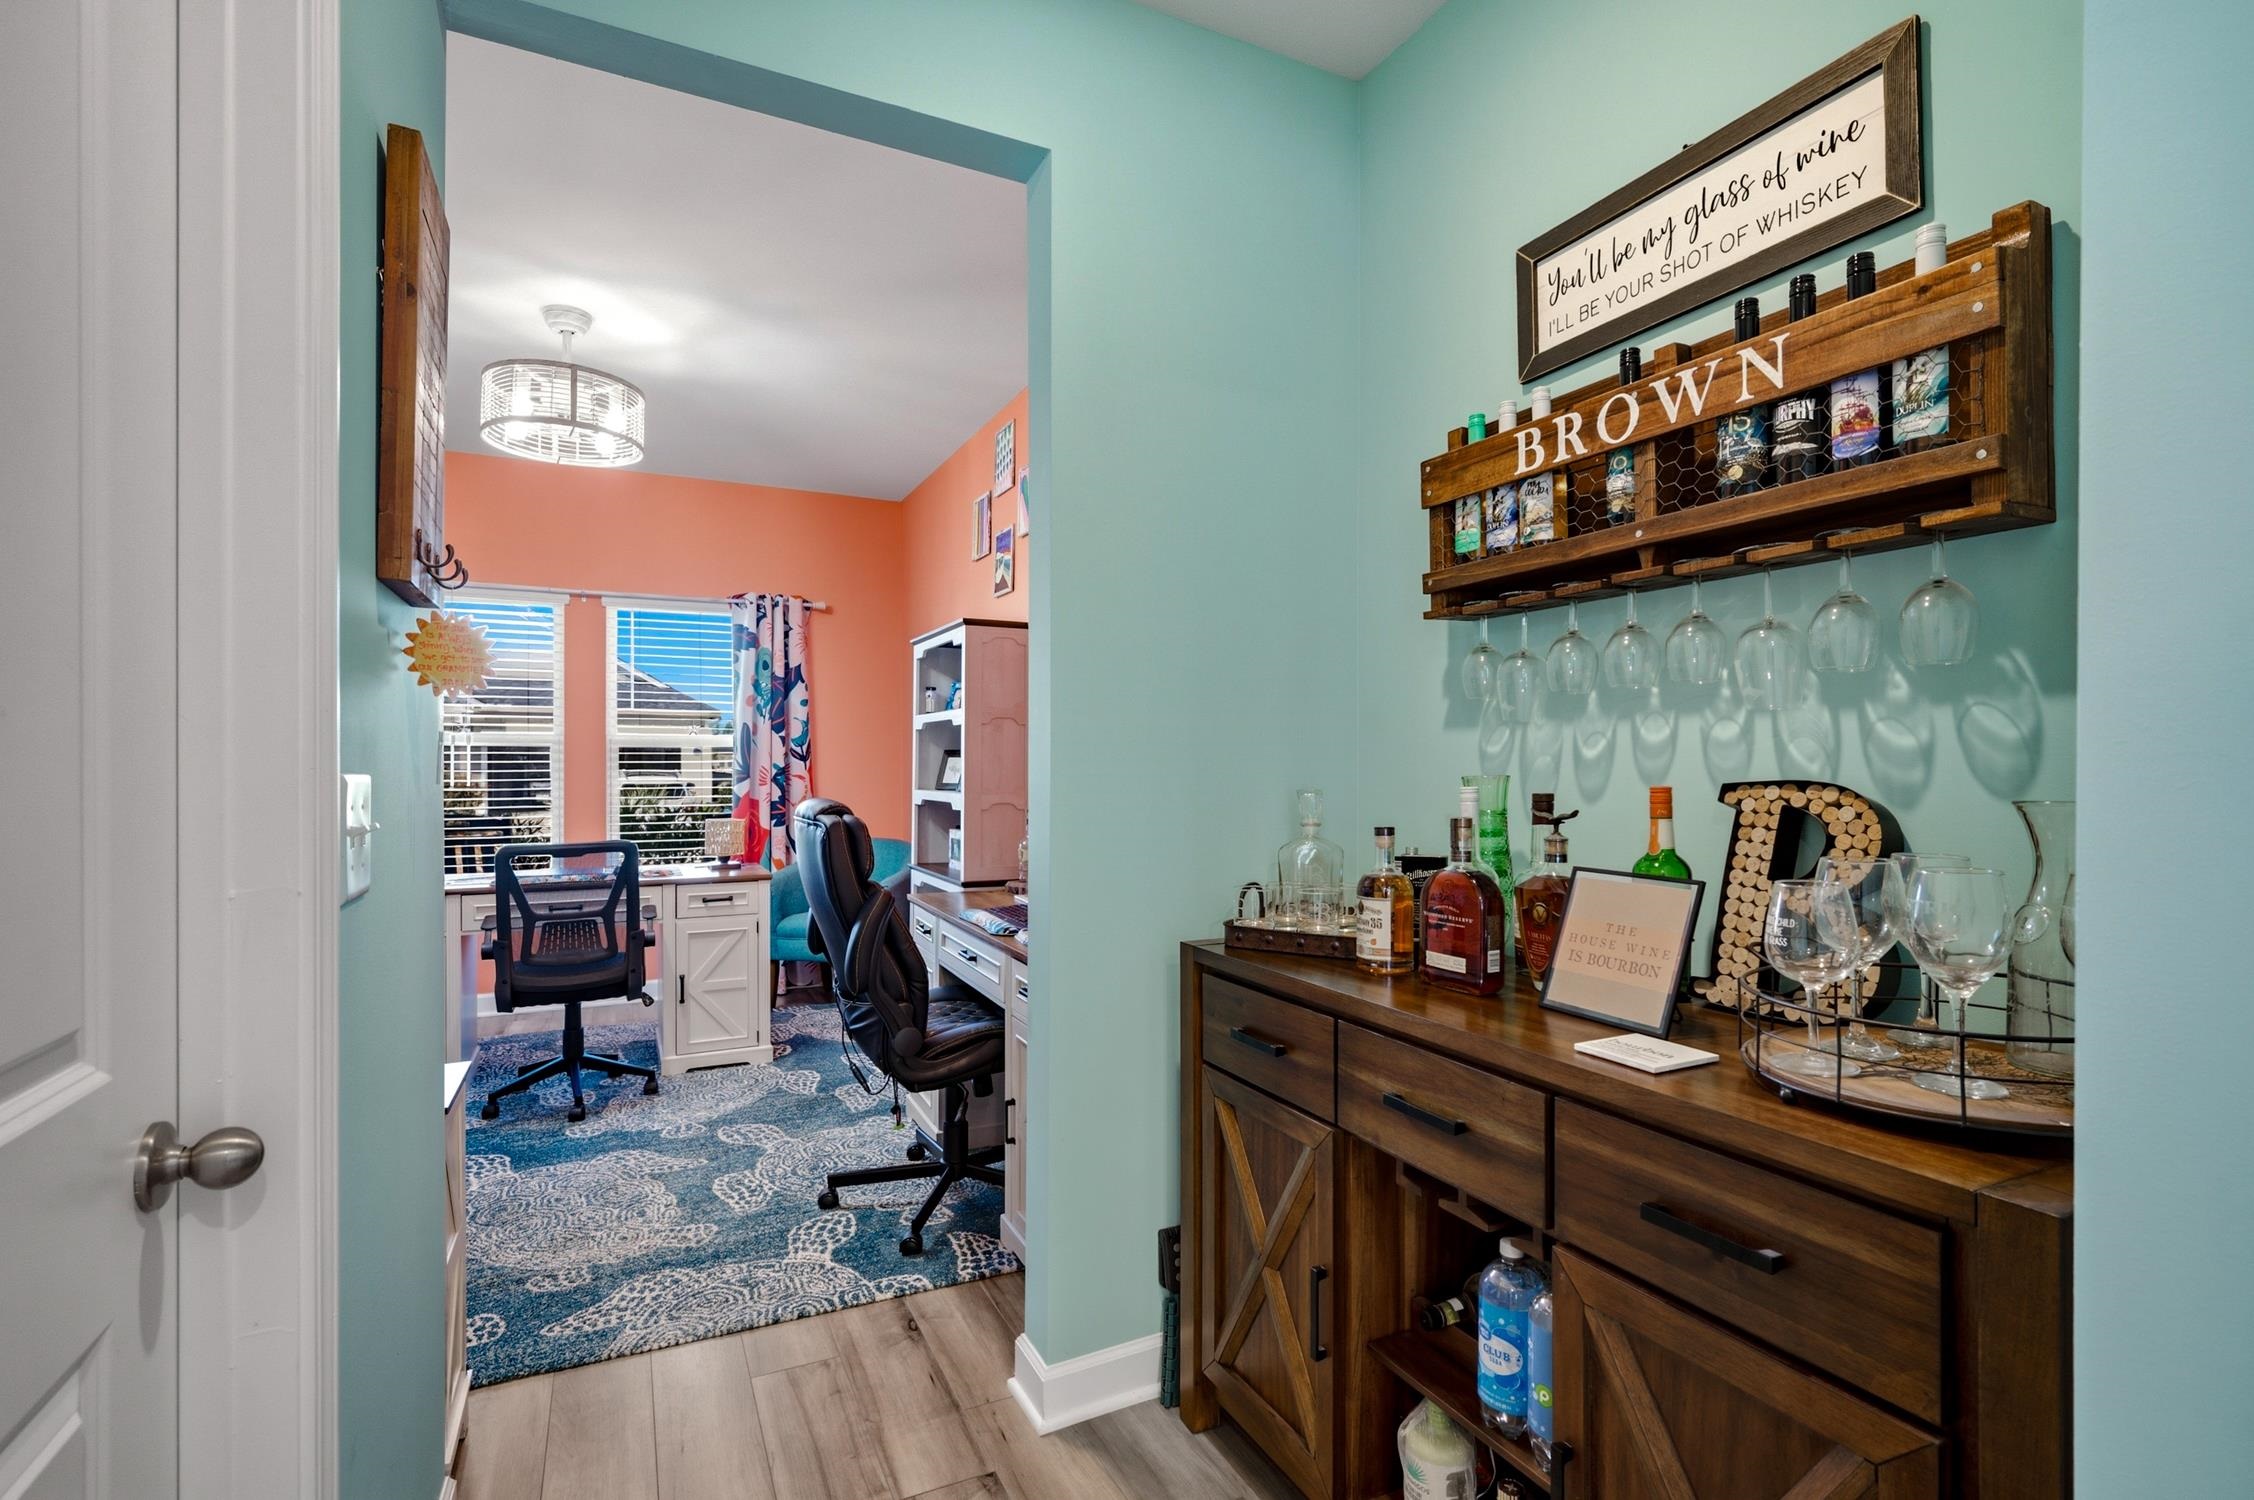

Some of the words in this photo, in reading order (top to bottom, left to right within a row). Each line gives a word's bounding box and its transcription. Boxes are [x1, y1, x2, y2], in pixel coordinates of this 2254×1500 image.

[1548, 248, 1607, 306] You'll
[1613, 236, 1637, 272] be
[1643, 216, 1676, 260] my
[1684, 174, 1755, 244] glass
[1763, 151, 1789, 190] of
[1796, 120, 1866, 172] wine
[1549, 313, 1574, 337] I'LL
[1579, 298, 1600, 323] BE
[1605, 272, 1654, 308] YOUR
[1660, 242, 1713, 283] SHOT
[1720, 224, 1749, 253] OF
[1756, 165, 1867, 235] WHISKEY
[1513, 332, 1791, 476] BROWN
[1775, 398, 1816, 422] URPHY
[1606, 922, 1638, 937] THE
[1568, 932, 1617, 950] HOUSE
[1626, 942, 1671, 960] WINE
[1568, 949, 1583, 963] IS
[1586, 952, 1662, 979] BOURBON
[1483, 1343, 1511, 1362] CLUB
